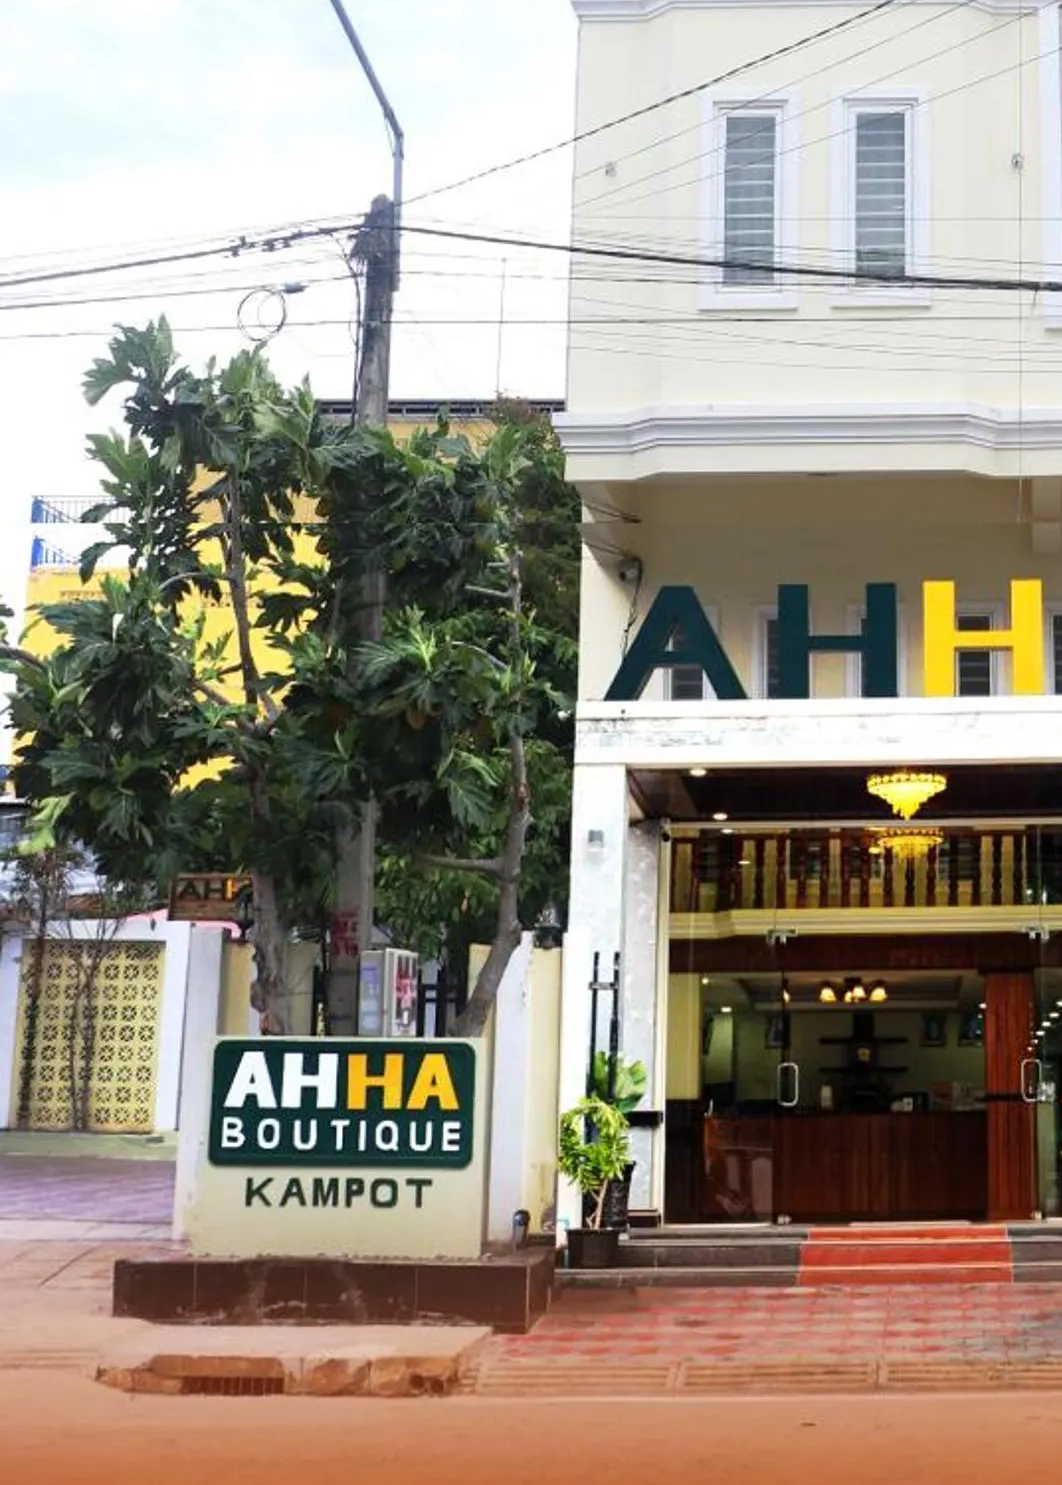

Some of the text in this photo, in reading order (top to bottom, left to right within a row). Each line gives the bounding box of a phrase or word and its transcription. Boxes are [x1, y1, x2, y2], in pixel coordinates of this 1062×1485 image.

[222, 1050, 461, 1110] AHHA
[220, 1116, 462, 1152] BOUTIQUE
[243, 1176, 434, 1209] KAMPOT
